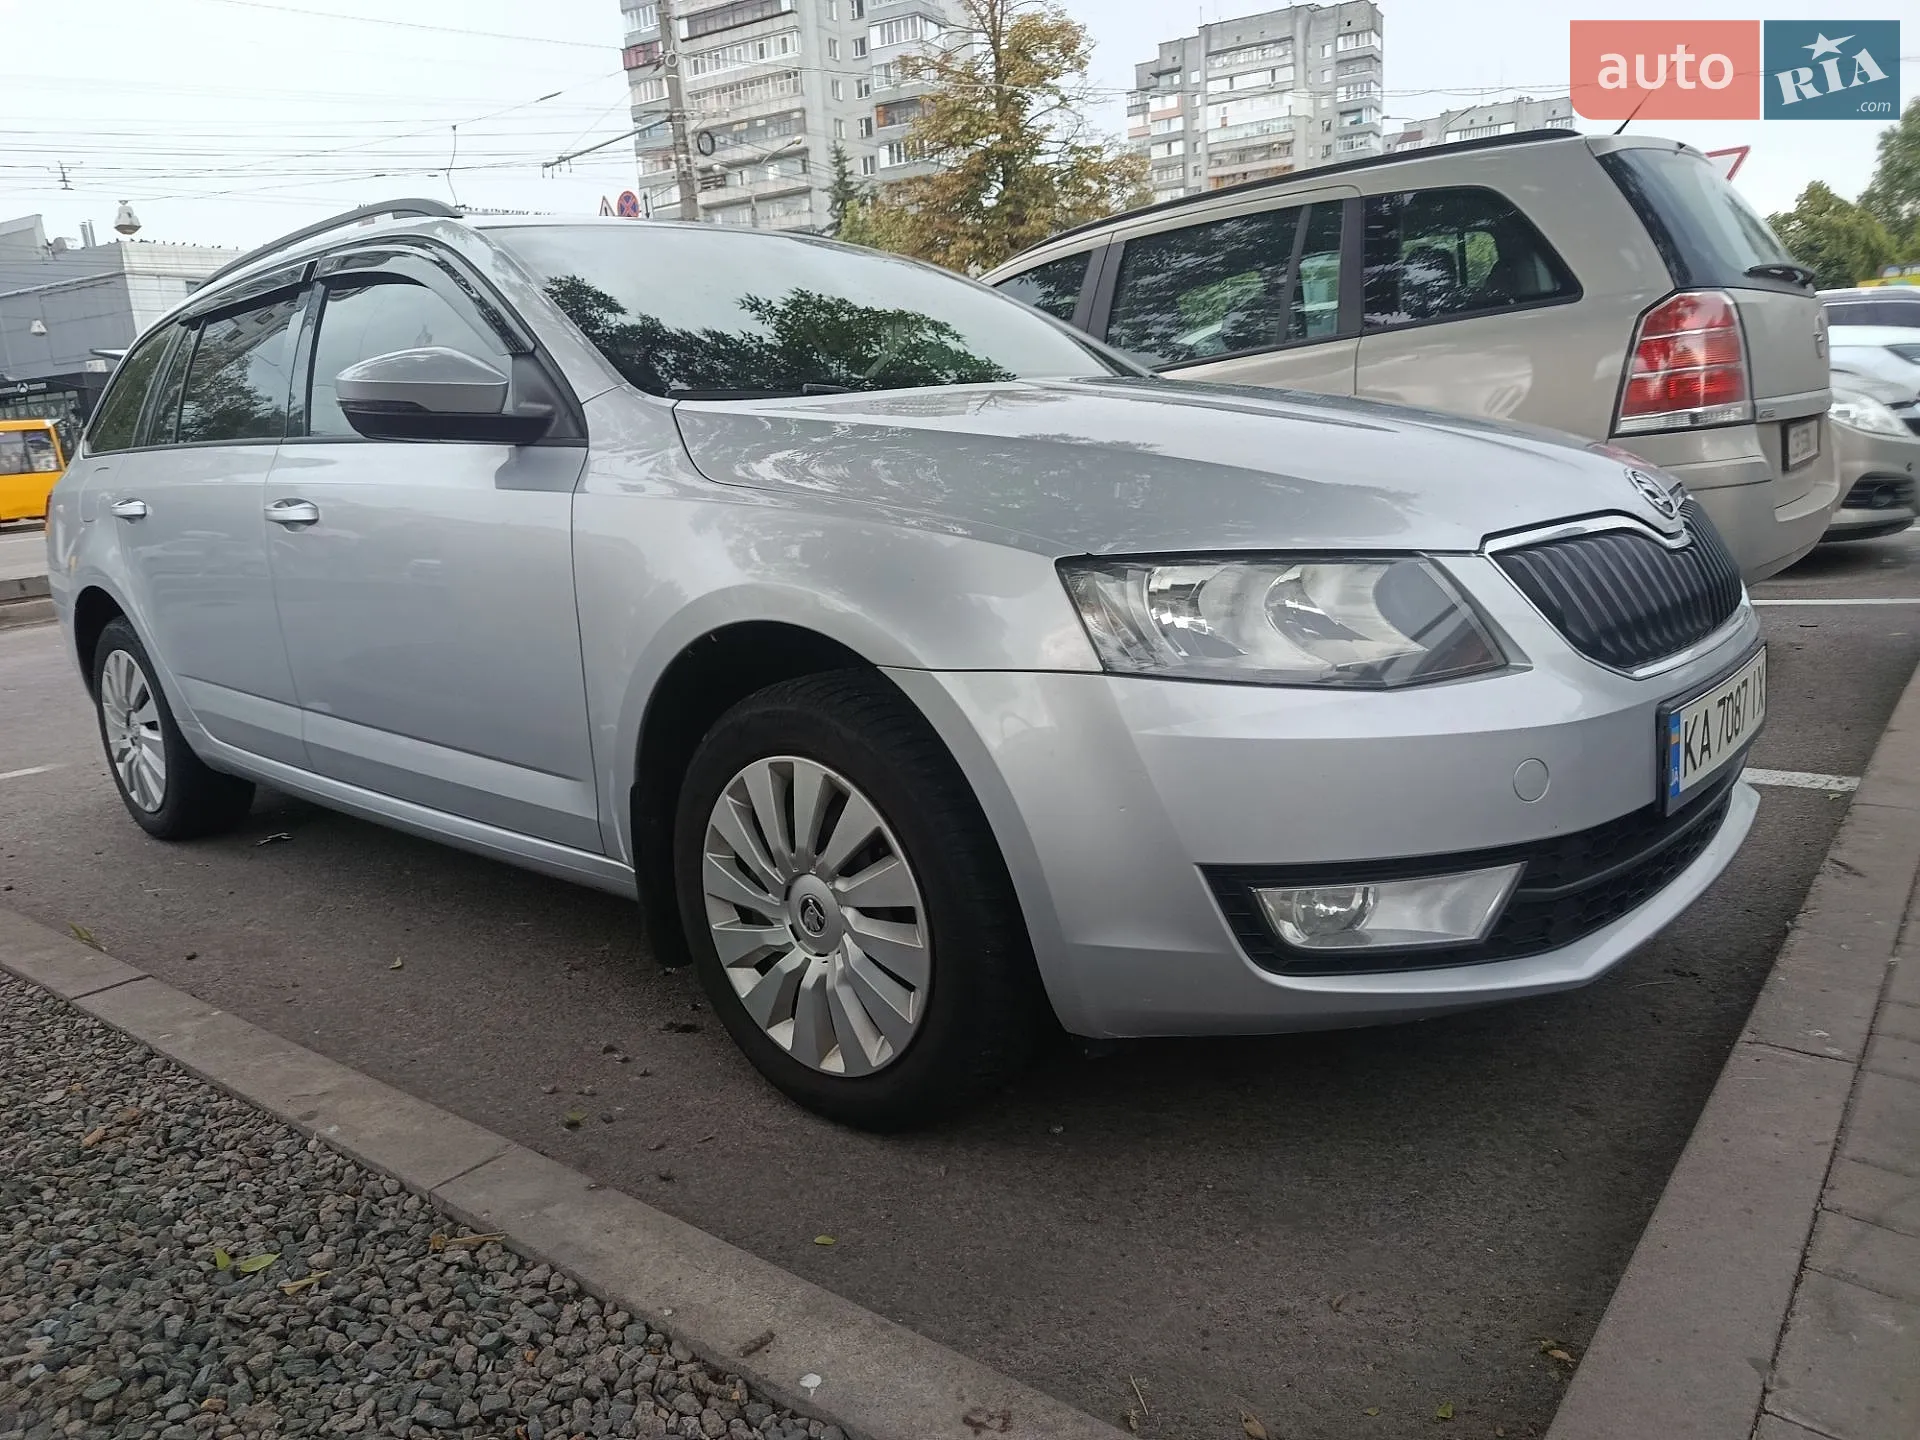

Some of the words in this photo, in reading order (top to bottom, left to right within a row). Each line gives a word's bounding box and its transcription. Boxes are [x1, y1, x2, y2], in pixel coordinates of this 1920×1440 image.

[1683, 708, 1712, 778] KA
[1717, 677, 1748, 753] 7087
[1752, 660, 1765, 720] IX
